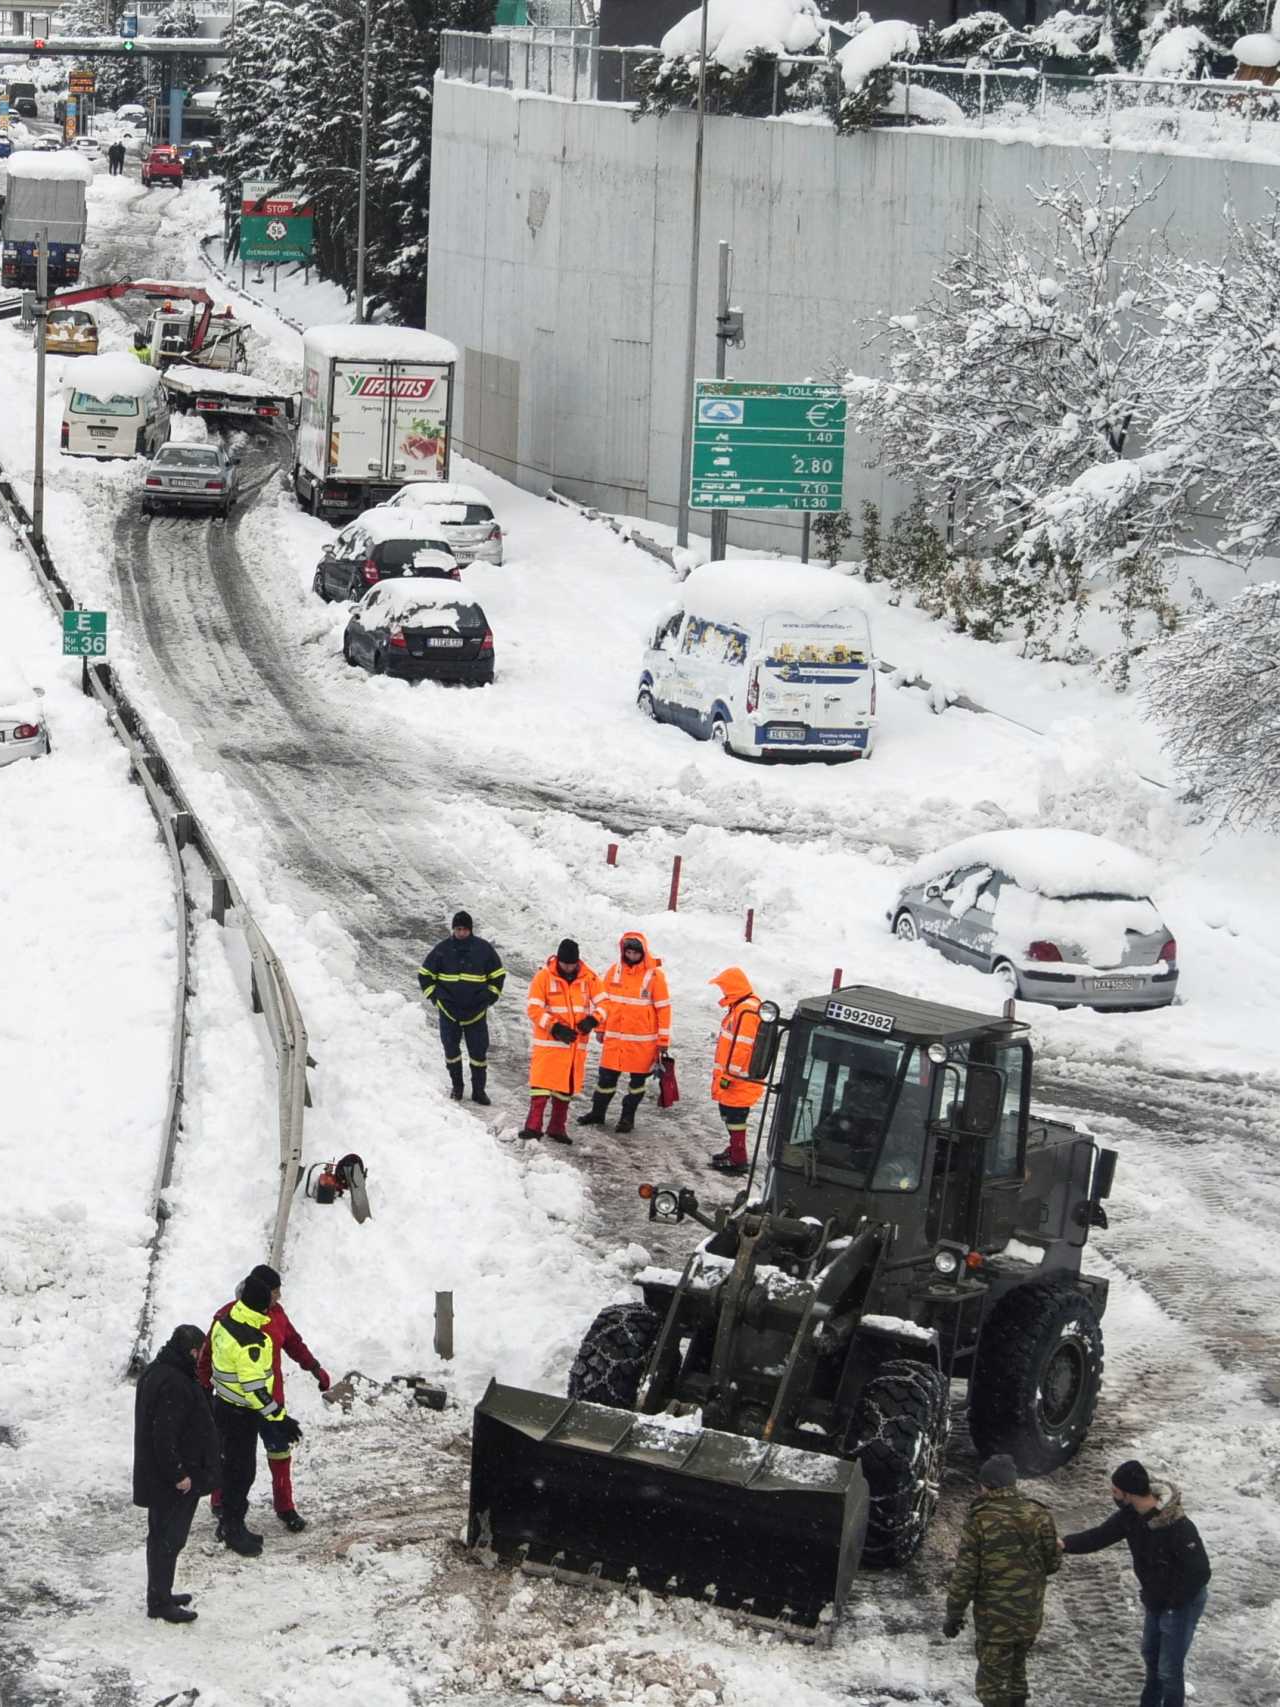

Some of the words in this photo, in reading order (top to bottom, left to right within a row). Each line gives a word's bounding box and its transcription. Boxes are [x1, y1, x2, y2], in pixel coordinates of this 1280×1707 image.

[266, 205, 289, 213] STOP
[363, 379, 427, 396] IFANTIS
[787, 387, 812, 396] TOLL
[807, 433, 833, 442] 1.40
[794, 460, 833, 474] 2.80
[801, 483, 829, 493] 7.10
[792, 498, 828, 508] 11.30
[78, 614, 92, 631] E
[80, 636, 105, 653] 36
[842, 1008, 892, 1031] 992982
